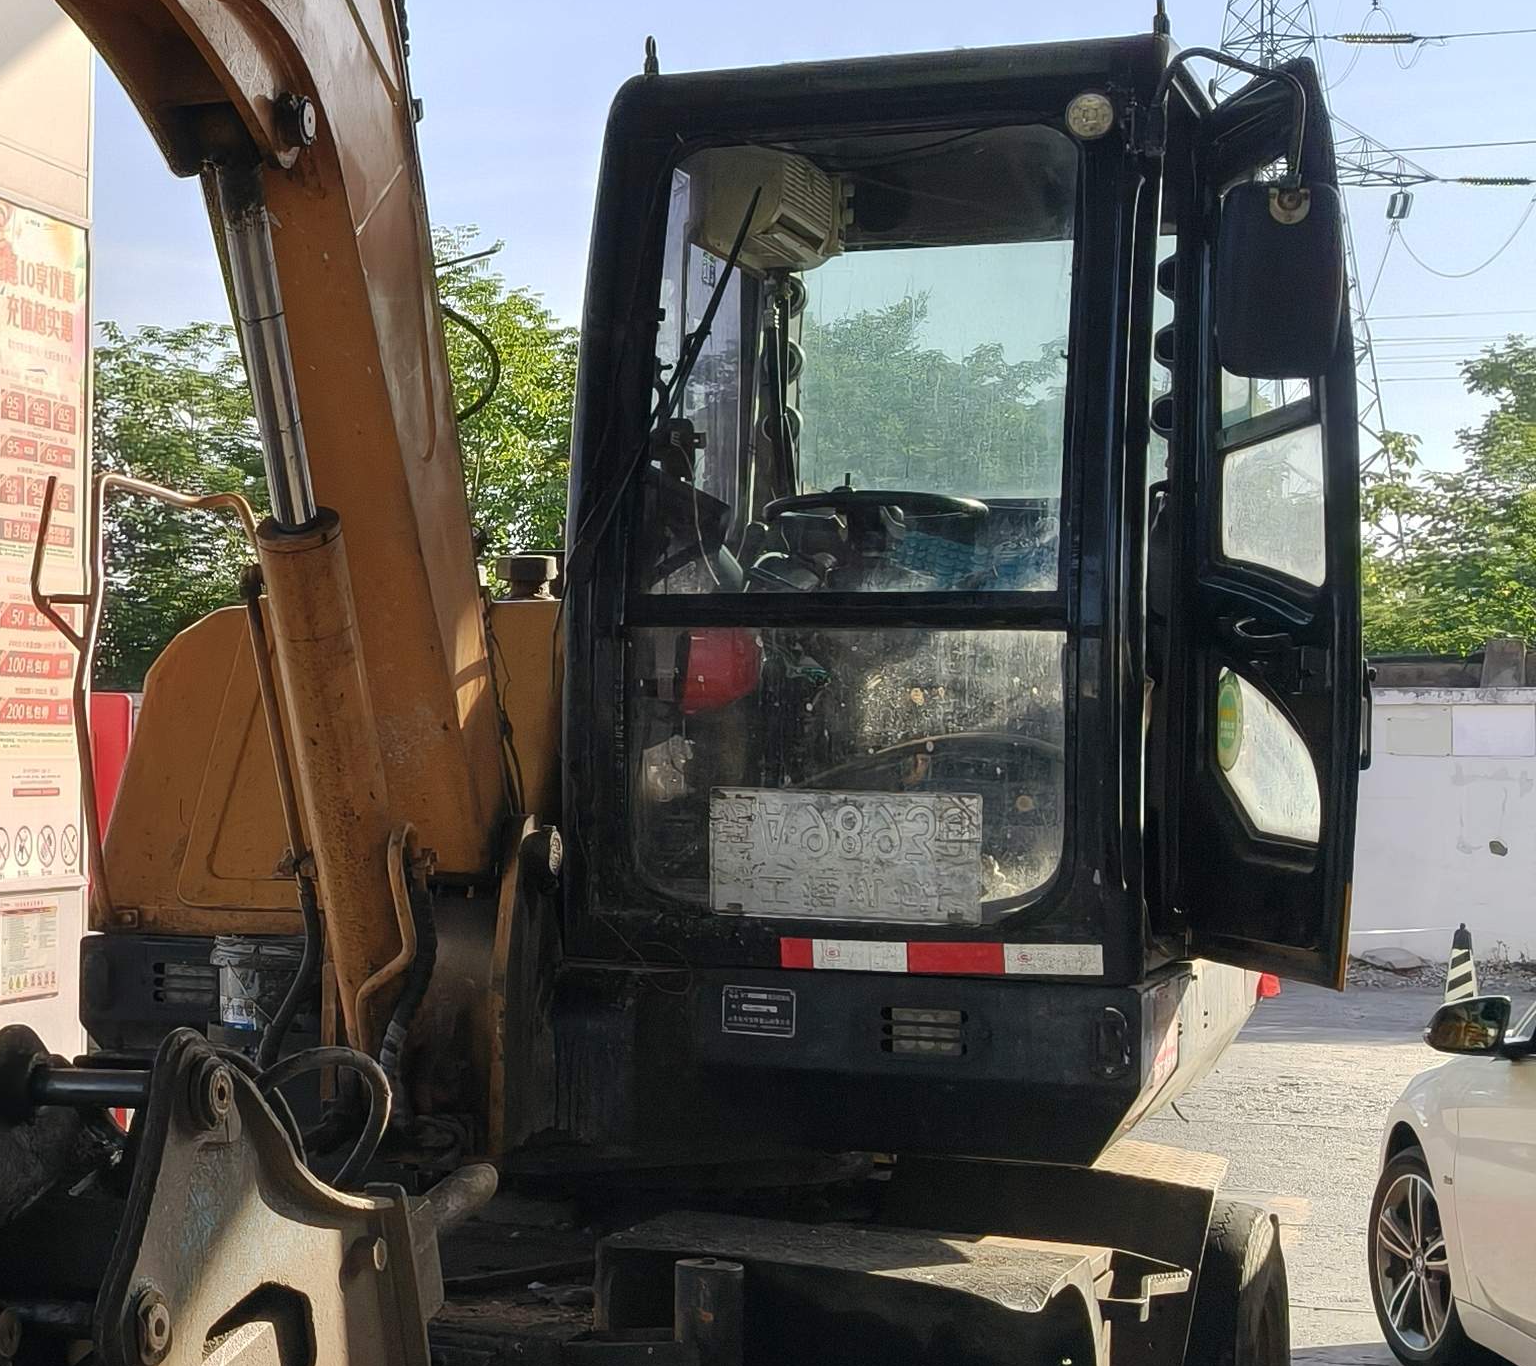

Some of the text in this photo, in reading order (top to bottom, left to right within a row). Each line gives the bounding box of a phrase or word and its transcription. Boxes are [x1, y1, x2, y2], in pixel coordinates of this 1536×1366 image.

[6, 293, 74, 343] 充值超实惠
